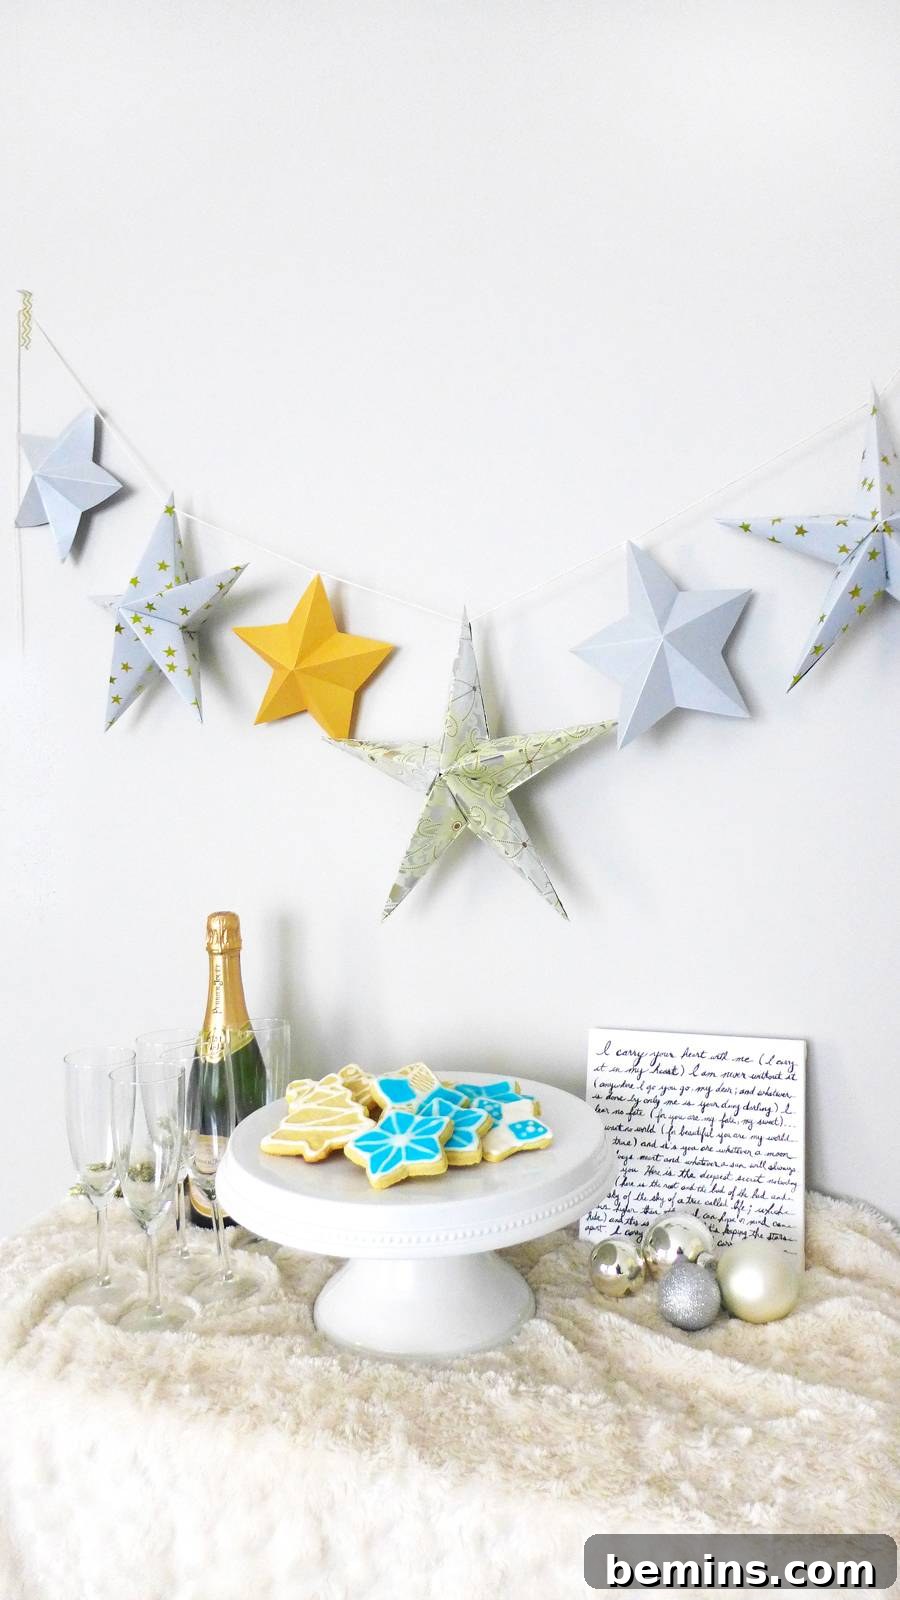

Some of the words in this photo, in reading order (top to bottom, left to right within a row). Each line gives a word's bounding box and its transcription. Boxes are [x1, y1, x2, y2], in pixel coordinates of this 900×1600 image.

[616, 1049, 648, 1067] carry
[649, 1051, 676, 1067] your
[681, 1047, 708, 1060] heart
[708, 1051, 729, 1061] with
[593, 1063, 607, 1072] it
[624, 1067, 649, 1081] my
[720, 1071, 747, 1080] never
[748, 1070, 784, 1081] without
[785, 1073, 797, 1081] it
[646, 1086, 656, 1095] go
[658, 1086, 678, 1097] you
[695, 1085, 712, 1100] my
[739, 1085, 756, 1095] and
[605, 1093, 626, 1102] done
[627, 1094, 640, 1108] by
[643, 1095, 661, 1109] only
[696, 1101, 719, 1114] your
[626, 1104, 645, 1122] fate
[667, 1114, 686, 1126] you
[702, 1116, 715, 1127] my
[740, 1119, 755, 1130] my
[604, 1123, 625, 1132] want
[634, 1124, 656, 1133] world
[680, 1124, 714, 1143] beautiful
[717, 1132, 731, 1144] you
[732, 1132, 747, 1140] are
[750, 1135, 764, 1147] my
[640, 1139, 657, 1148] and
[680, 1145, 698, 1156] you
[764, 1151, 798, 1159] moon
[637, 1153, 663, 1161] meant
[663, 1156, 681, 1164] and
[749, 1161, 767, 1171] will
[621, 1167, 638, 1177] you
[662, 1167, 676, 1176] is
[678, 1168, 696, 1179] the
[700, 1170, 731, 1186] deepest
[735, 1174, 766, 1183] secret
[649, 1179, 662, 1188] the
[663, 1182, 679, 1190] root
[680, 1183, 697, 1191] and
[710, 1182, 726, 1194] bud
[728, 1185, 738, 1200] of
[737, 1187, 749, 1199] the
[607, 1190, 620, 1206] sky
[623, 1191, 632, 1212] of
[634, 1191, 648, 1201] the
[649, 1192, 665, 1208] sky
[667, 1192, 677, 1208] of
[686, 1195, 702, 1204] tree
[704, 1197, 728, 1208] called
[608, 1214, 624, 1224] and
[623, 1215, 639, 1226] this
[748, 1227, 764, 1239] the
[702, 1212, 718, 1220] can
[718, 1211, 736, 1228] hope
[624, 1229, 643, 1244] carry
